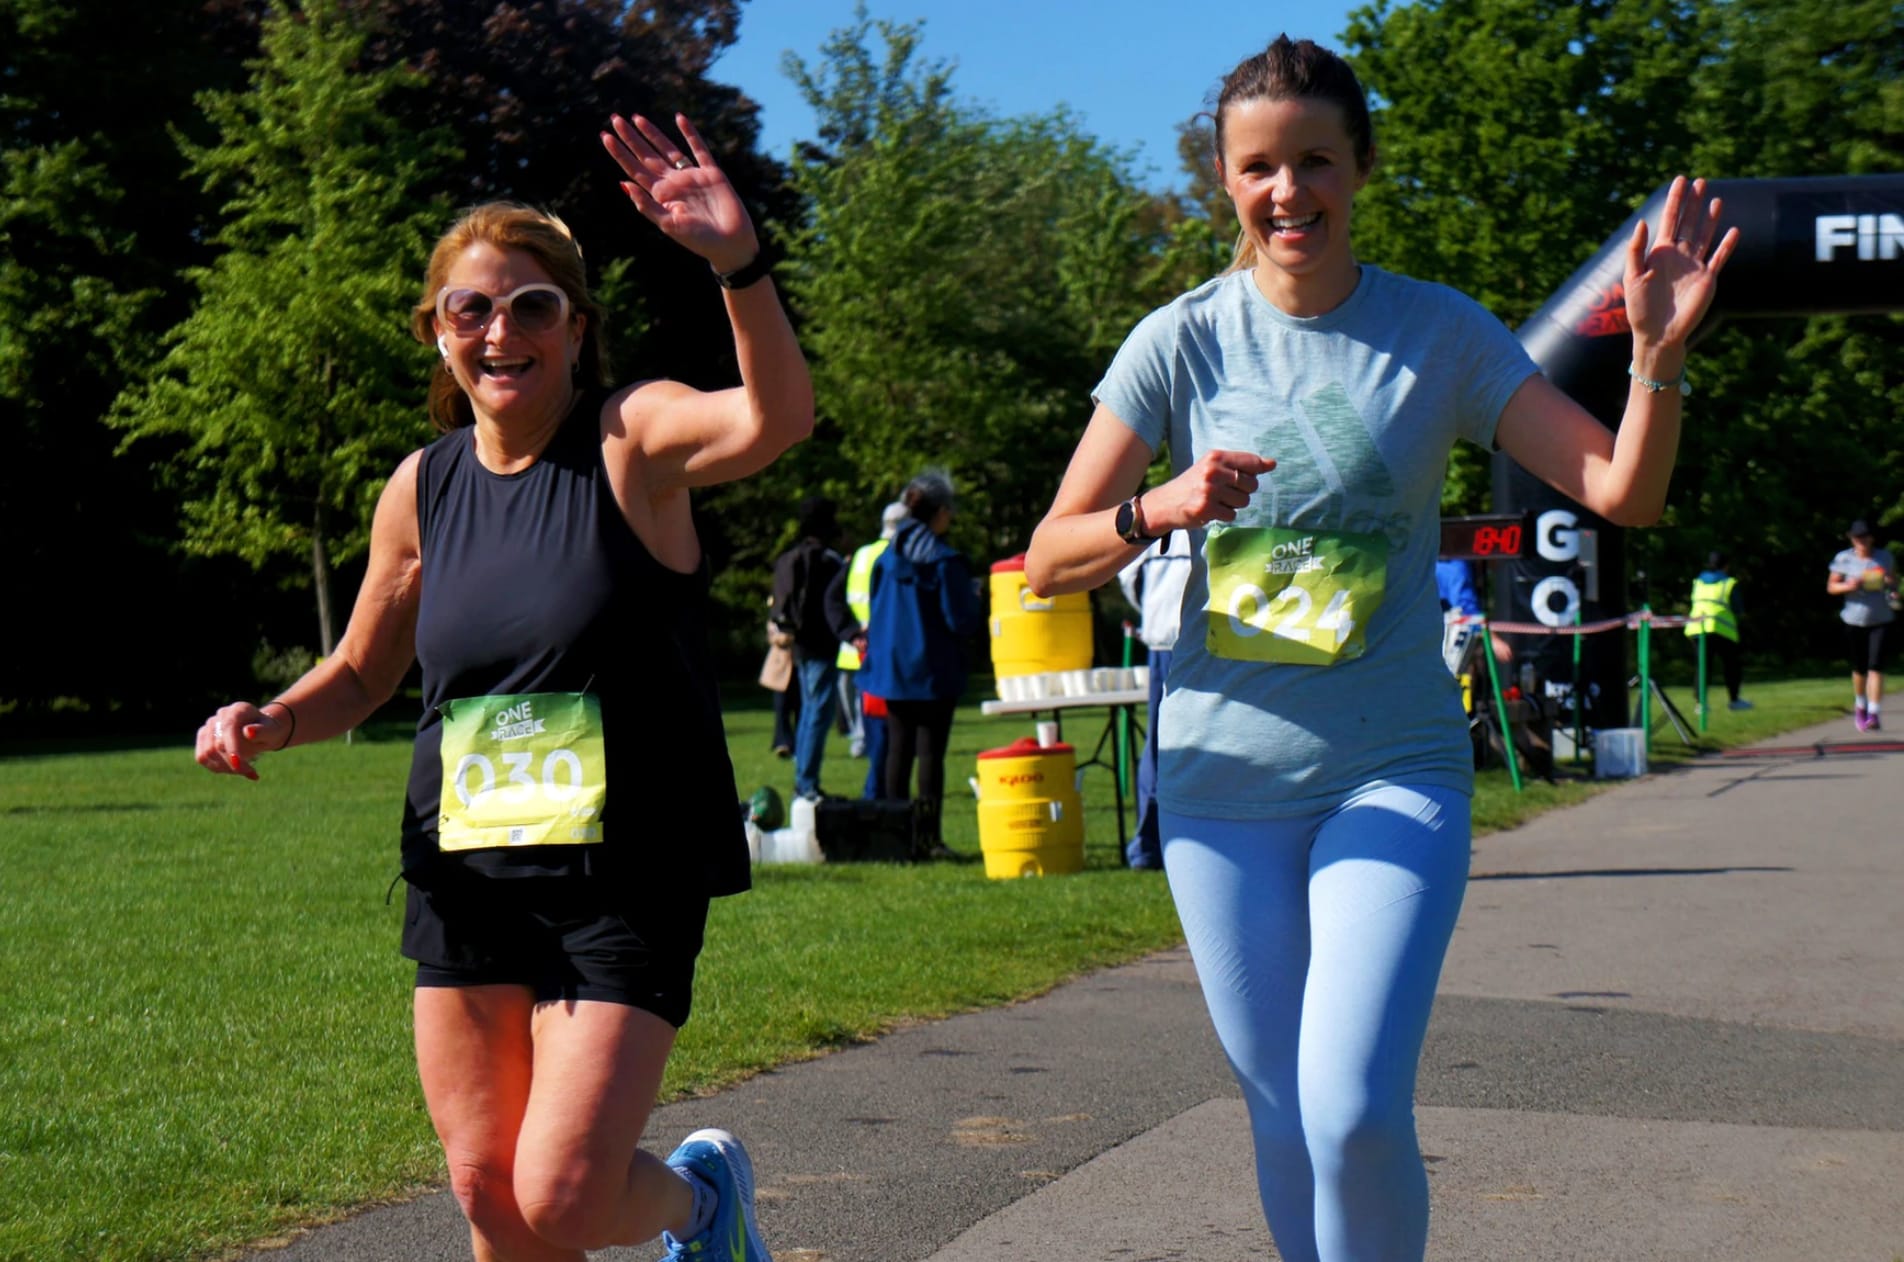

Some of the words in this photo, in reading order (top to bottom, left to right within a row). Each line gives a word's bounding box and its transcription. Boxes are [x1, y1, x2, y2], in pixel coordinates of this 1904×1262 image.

[1271, 536, 1313, 559] ONE
[1272, 557, 1312, 574] RACE
[1228, 583, 1356, 644] 024
[496, 700, 532, 726] ONE
[498, 720, 534, 740] RACE
[455, 749, 584, 809] 030
